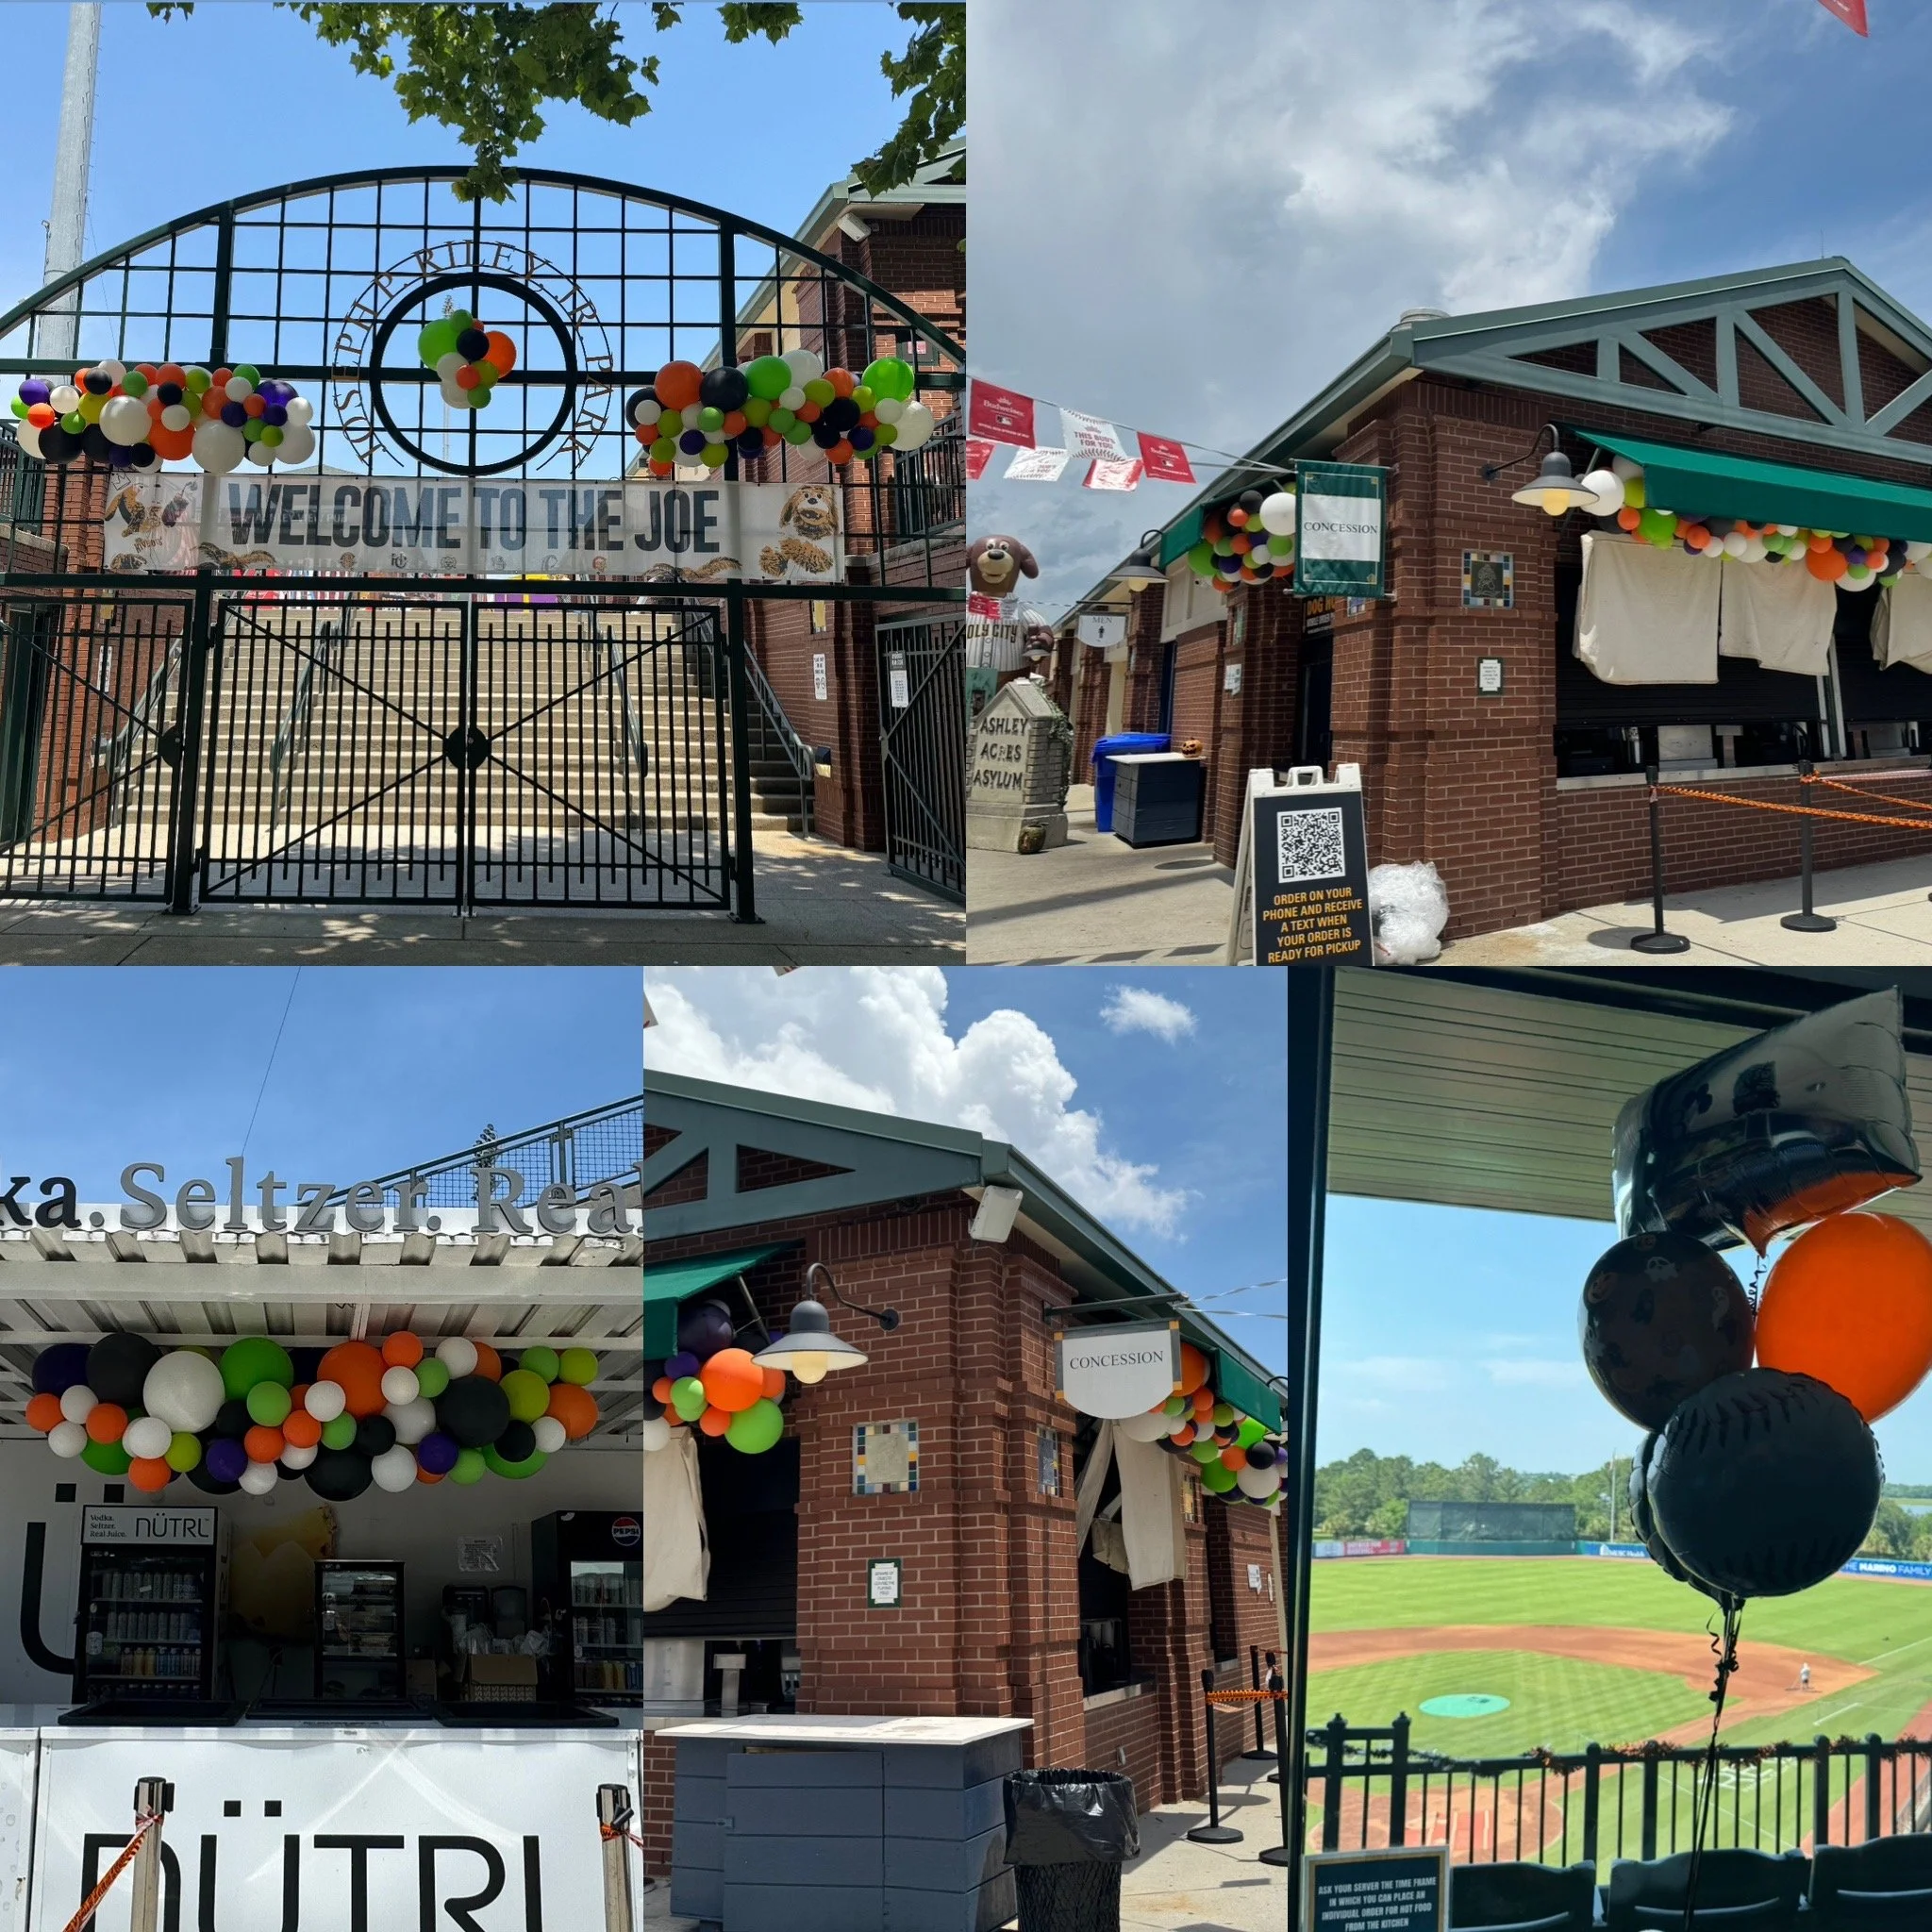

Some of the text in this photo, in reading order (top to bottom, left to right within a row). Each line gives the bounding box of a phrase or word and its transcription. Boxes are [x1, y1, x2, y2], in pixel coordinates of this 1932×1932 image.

[331, 298, 387, 463] JOSEPH
[558, 353, 614, 468] PARK
[228, 483, 720, 553] WELCOME TO THE JOE
[1304, 522, 1377, 534] CONCESSION
[1091, 615, 1113, 625] MEN
[992, 624, 1018, 643] CITY
[980, 717, 1028, 736] ASHLEY
[980, 741, 1022, 762] ACRES
[974, 769, 1023, 791] ASYLUM
[1274, 887, 1352, 906] ORDER ON YOUR
[1263, 899, 1362, 921] PHONE AND RECEIVE
[1281, 914, 1347, 933] A TEXT WHEN
[1277, 927, 1352, 947] YOUR ORDER IS
[1268, 940, 1361, 963] READY FOR PICKUP
[121, 1157, 441, 1232] Seltzer.
[1070, 1350, 1163, 1370] CONCESSION
[613, 1526, 640, 1535] PEPSI
[1897, 1565, 1932, 1575] FAMILY
[1319, 1876, 1437, 1894] ASK YOUR SERVER THE TIME FRAME
[1329, 1890, 1425, 1907] IN WHICH YOU CAN PLACE AN
[1322, 1903, 1432, 1921] INDIVIDUAL ORDER FOR HOT FOOD
[1345, 1918, 1408, 1932] FROM THE KITCHEN
